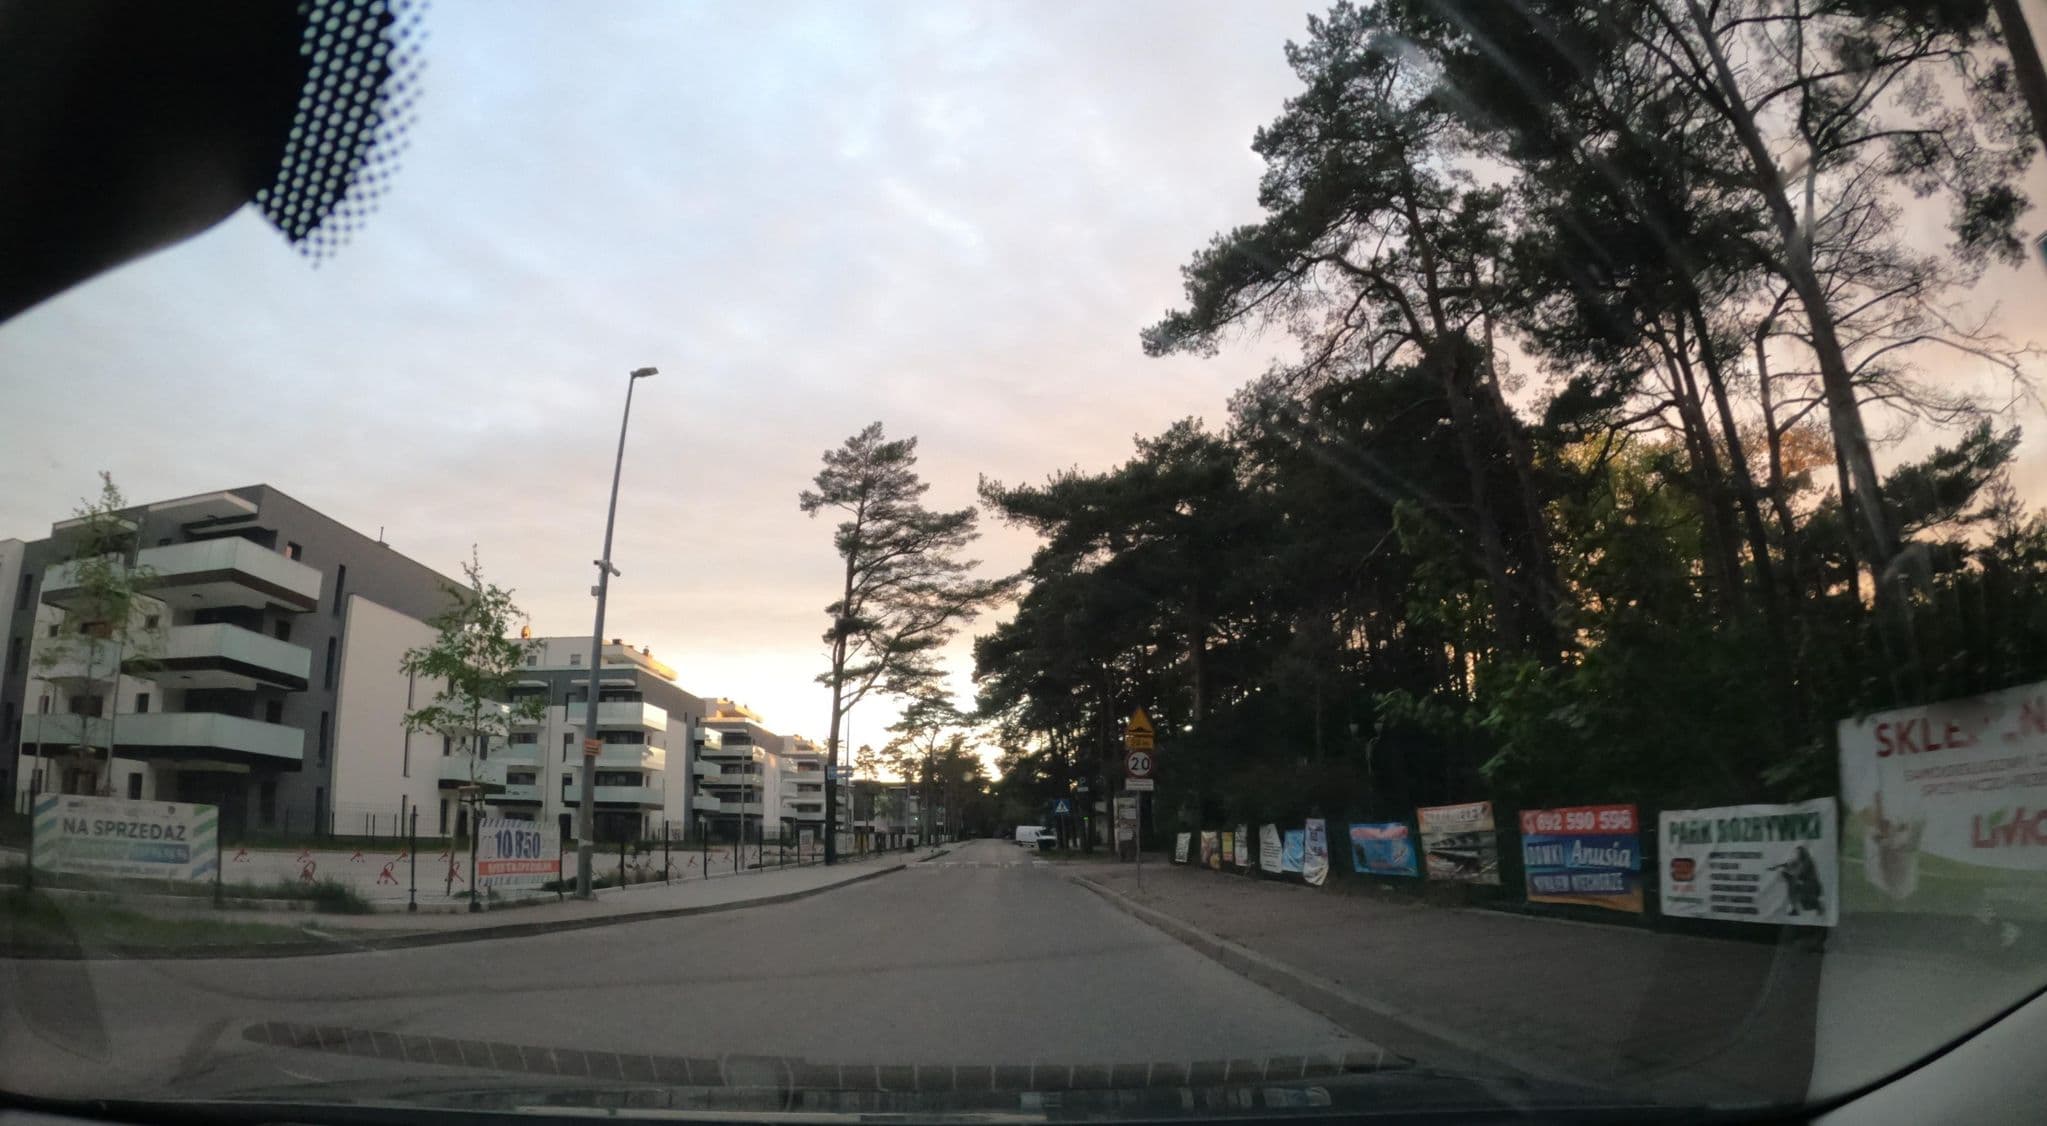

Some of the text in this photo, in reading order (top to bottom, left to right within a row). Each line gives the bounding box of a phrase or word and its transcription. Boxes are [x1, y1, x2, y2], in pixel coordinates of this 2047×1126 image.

[1131, 758, 1151, 772] 20
[63, 818, 89, 836] NA
[1570, 839, 1632, 869] Anusia
